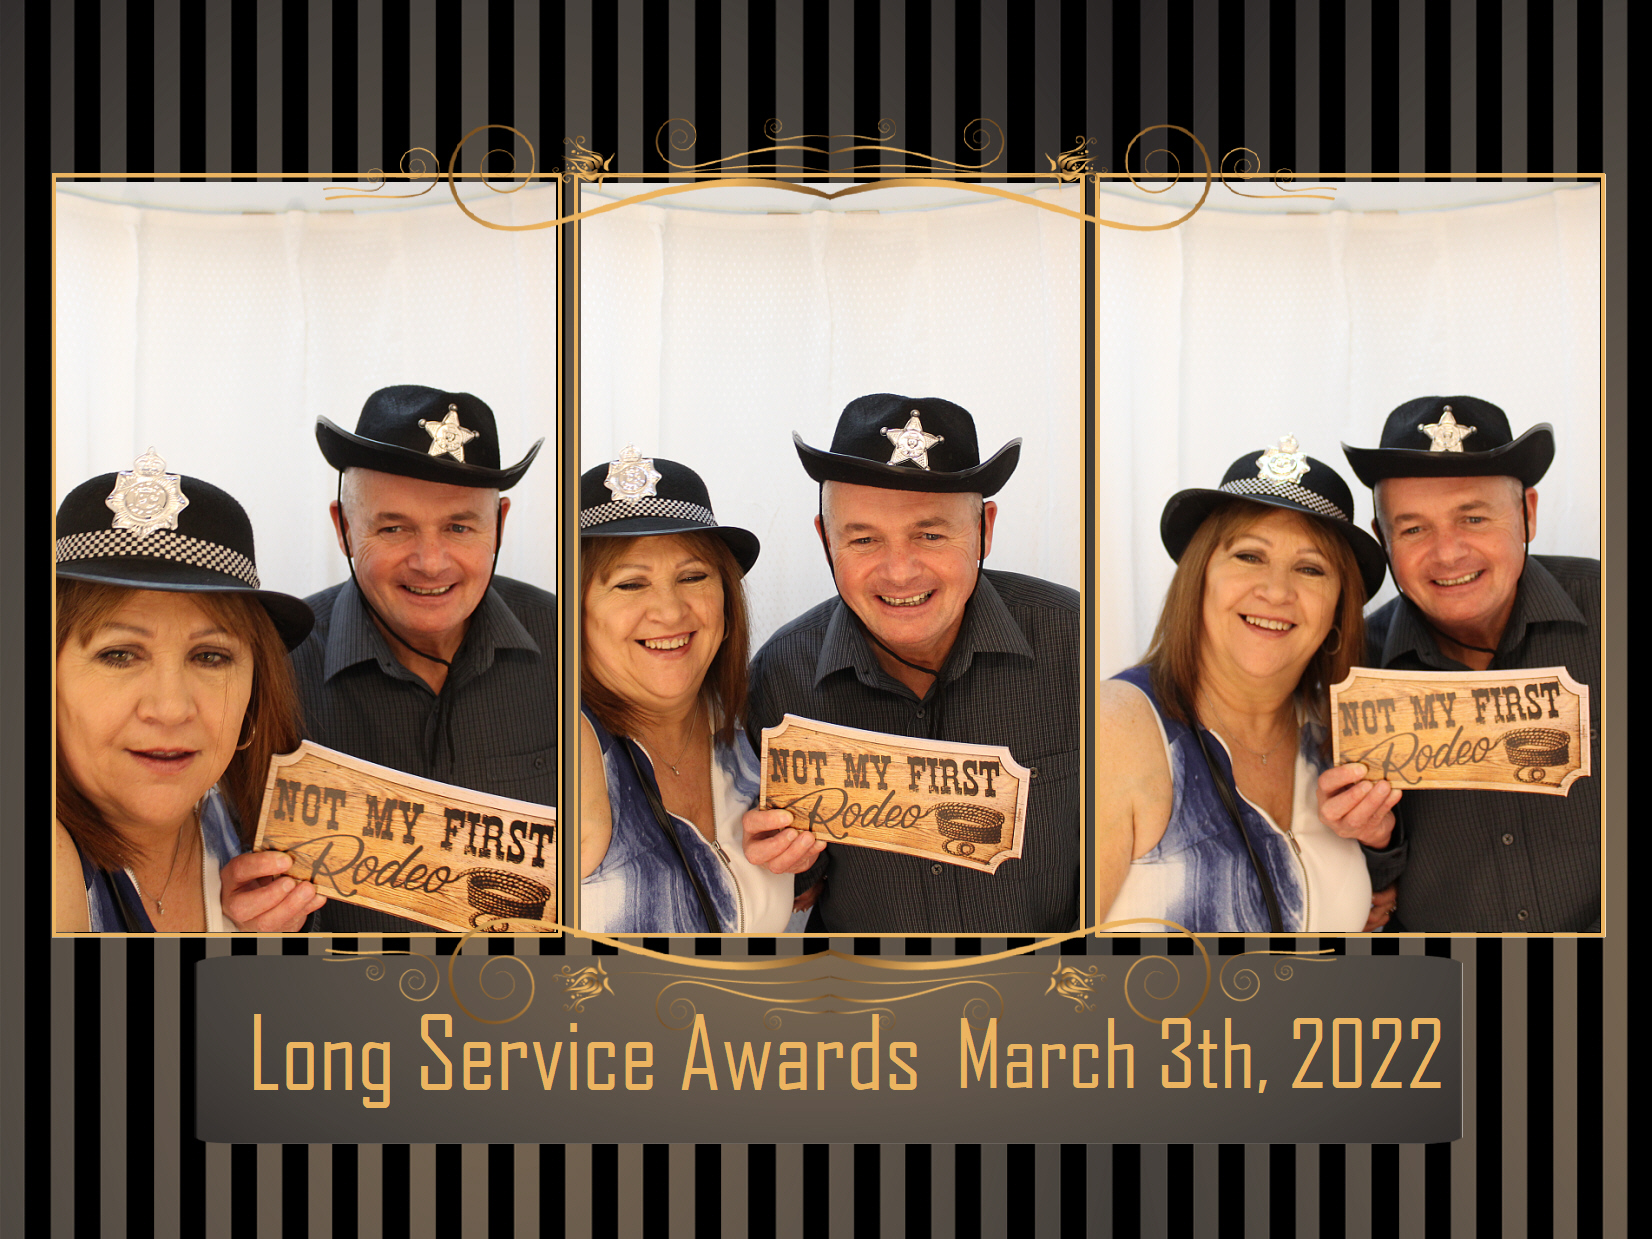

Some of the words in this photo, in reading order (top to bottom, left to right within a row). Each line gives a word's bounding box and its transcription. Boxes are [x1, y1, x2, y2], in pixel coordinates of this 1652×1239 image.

[1339, 698, 1395, 736] NOT
[1410, 692, 1456, 731] MY
[1471, 681, 1560, 724] FIRST
[769, 748, 827, 786] NOT
[843, 753, 892, 790] MY
[907, 756, 1000, 797] FIRST
[1360, 725, 1497, 785] Rodeo
[273, 778, 347, 831] NOT
[362, 794, 424, 844] MY
[440, 807, 556, 868] FIRST
[787, 787, 929, 840] Rodeo
[291, 834, 456, 897] Rodeo
